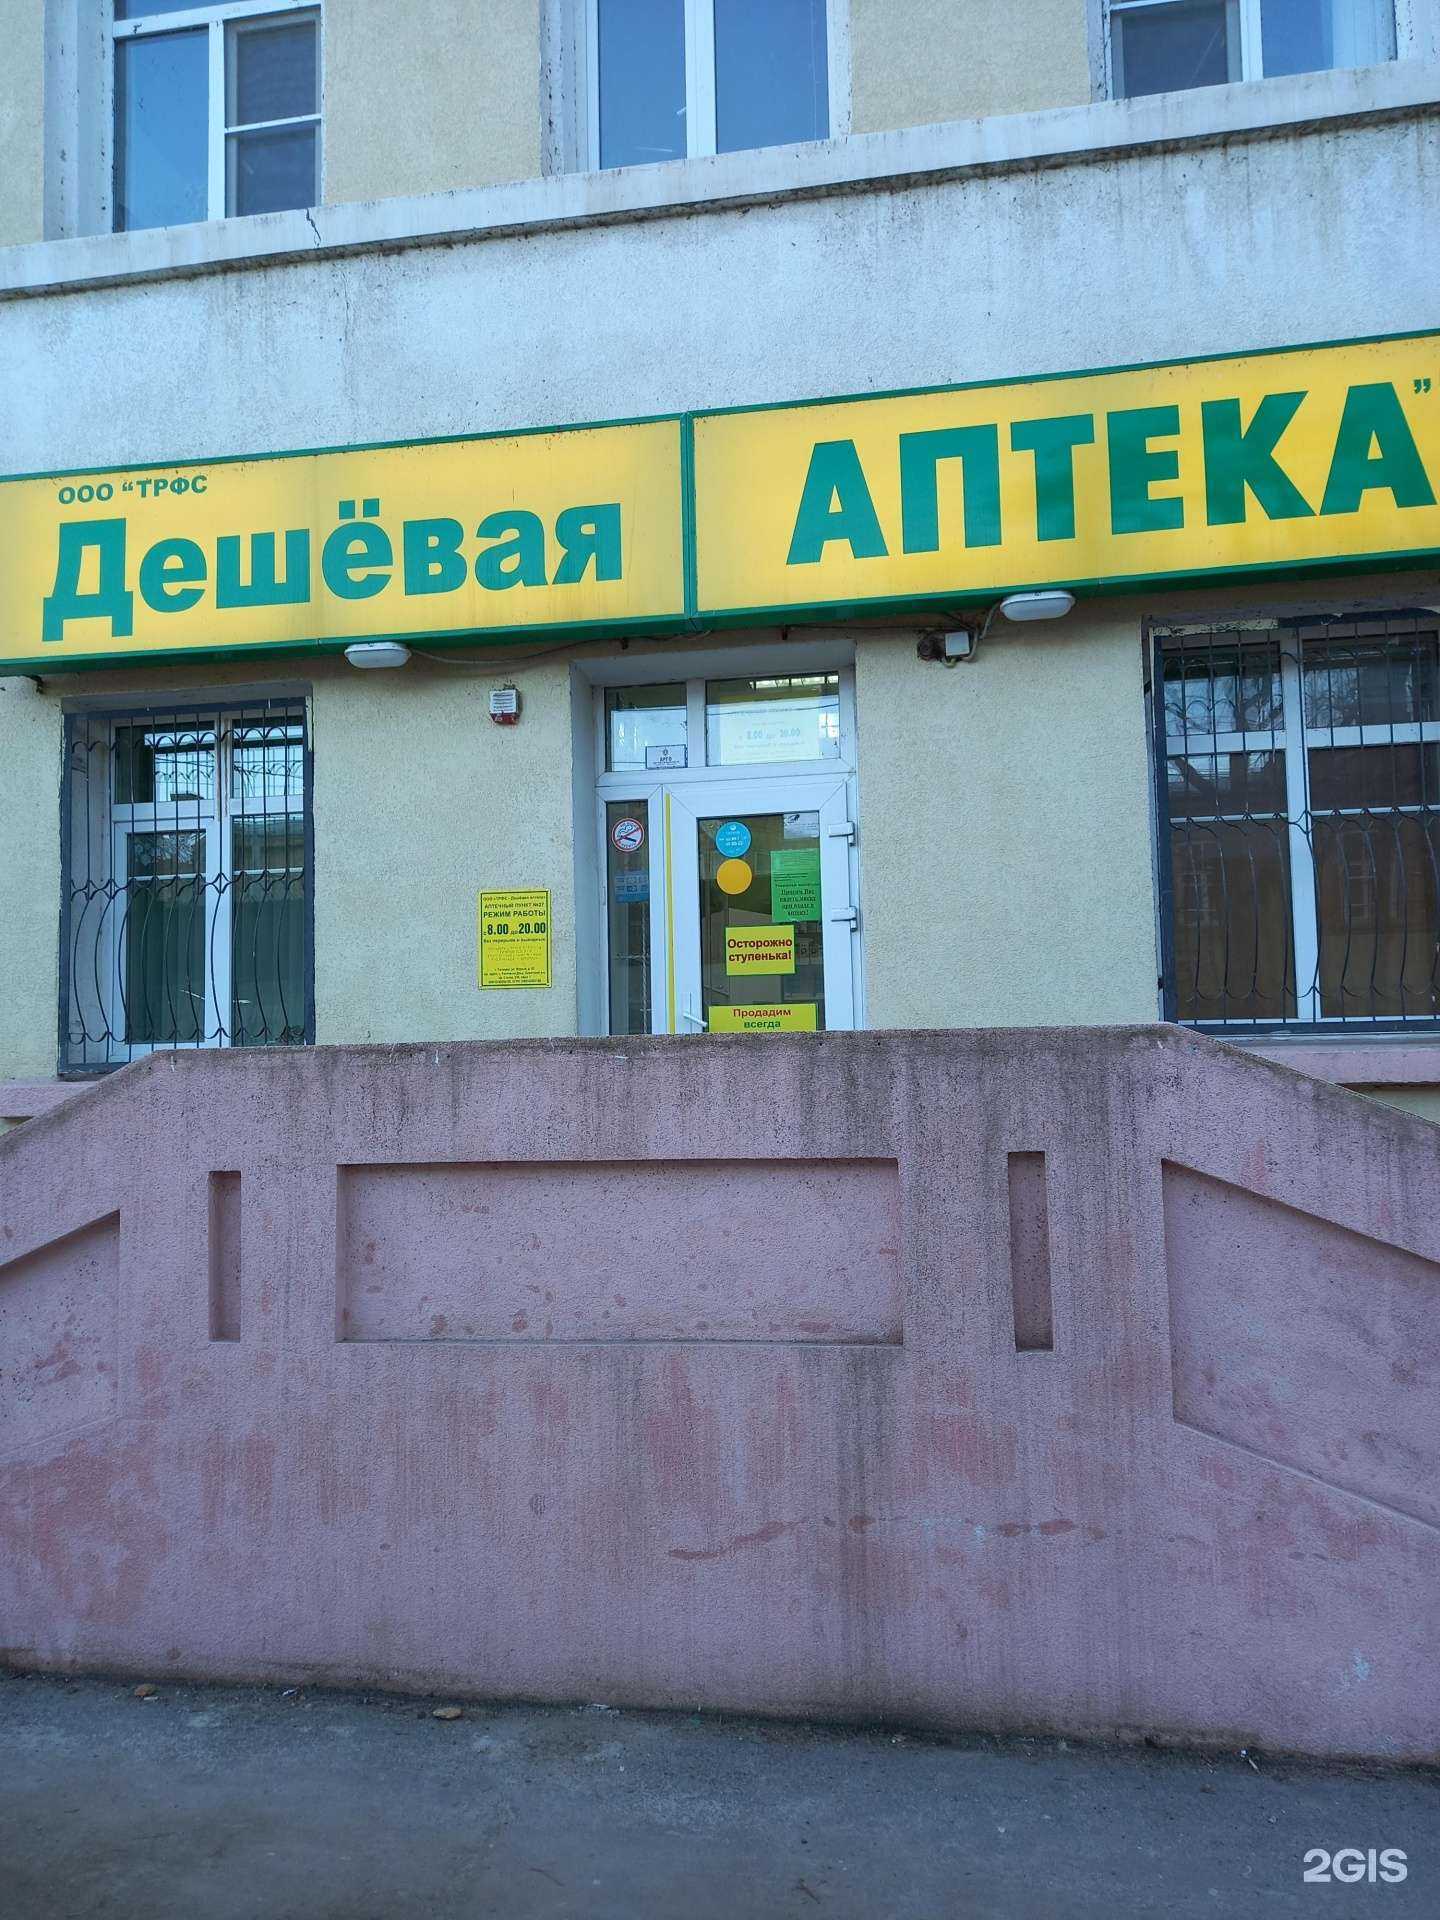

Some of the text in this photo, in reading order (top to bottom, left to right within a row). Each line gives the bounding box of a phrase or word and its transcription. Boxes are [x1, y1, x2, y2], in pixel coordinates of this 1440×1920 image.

[58, 484, 114, 505] ООО
[42, 497, 623, 642] Дешёвая
[513, 909, 546, 917] РАБОТЫ
[487, 923, 509, 935] 8.00
[518, 921, 546, 934] 20.00
[727, 938, 793, 949] Осторожно
[728, 950, 792, 963] ступенька!
[733, 1007, 792, 1019] Продадим
[743, 1020, 781, 1029] всегда
